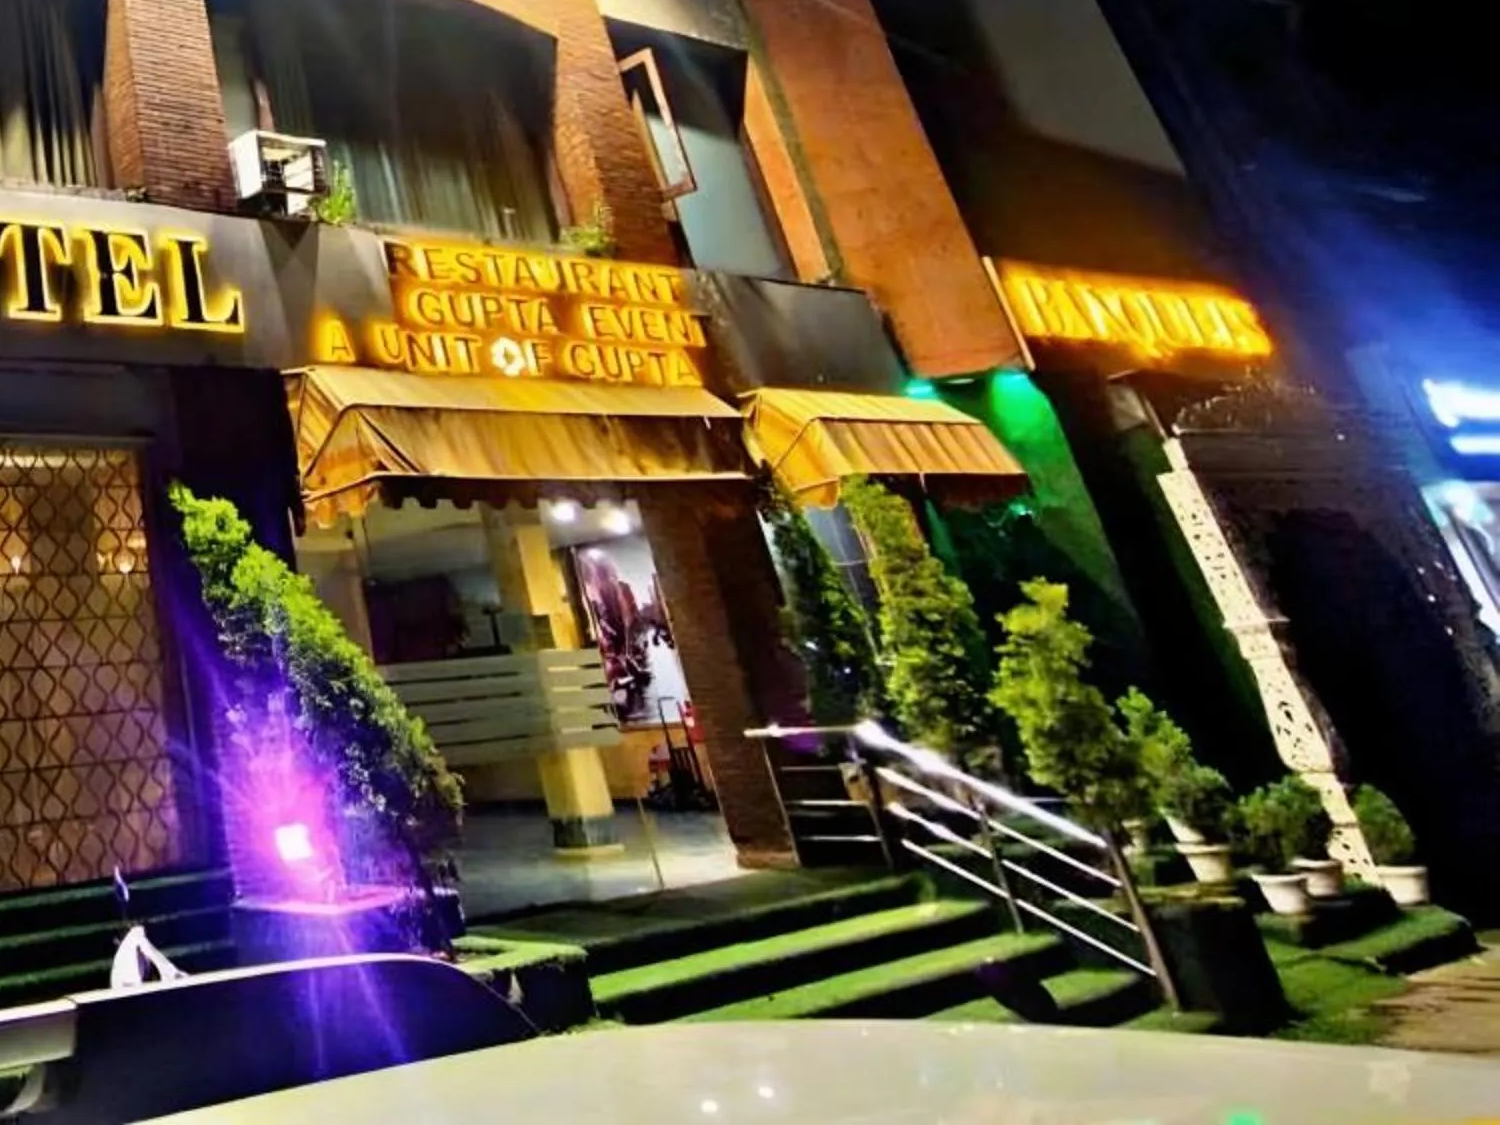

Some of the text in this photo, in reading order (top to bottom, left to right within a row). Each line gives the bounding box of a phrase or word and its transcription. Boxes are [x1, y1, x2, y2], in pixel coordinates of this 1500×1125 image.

[383, 240, 682, 303] RESTAURANT
[414, 288, 711, 347] GUPTA EVENT
[324, 320, 703, 386] A UNIT OF GUPTA
